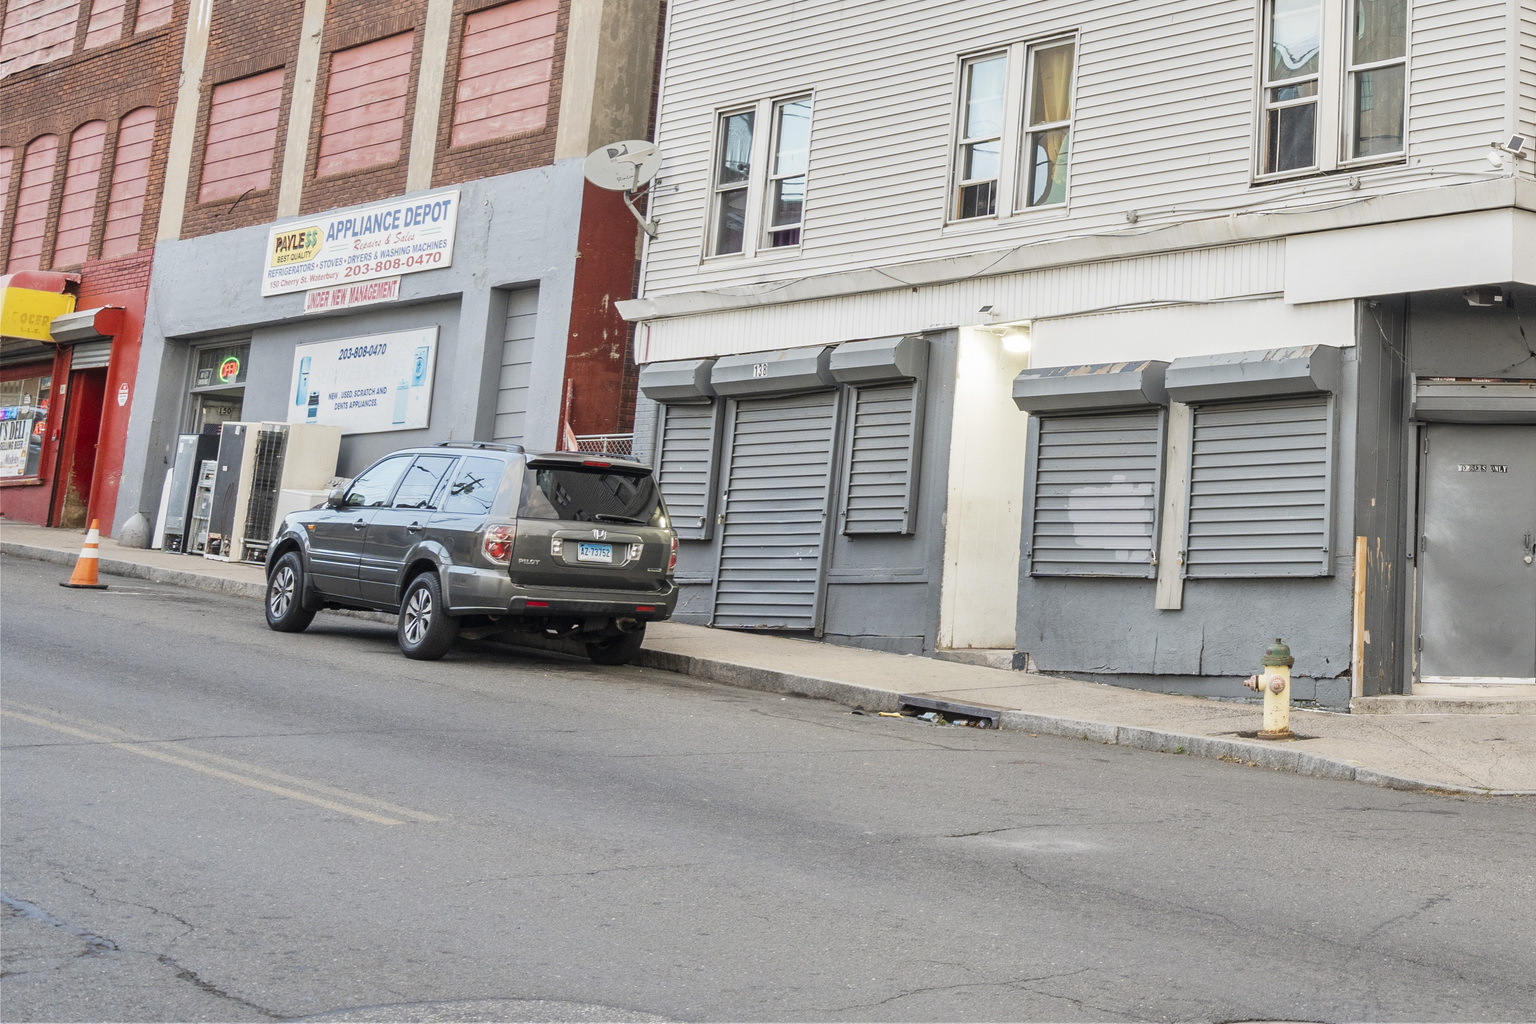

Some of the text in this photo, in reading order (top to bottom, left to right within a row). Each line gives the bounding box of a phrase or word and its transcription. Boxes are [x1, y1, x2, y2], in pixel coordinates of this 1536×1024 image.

[326, 199, 452, 242] APPLIANCE DEPOT
[352, 231, 416, 252] Repairs & Sales
[267, 238, 448, 279] REFRIGERATORS STOVES DRYERS & WASHING MACHINES
[277, 250, 312, 264] BEST QUALITY
[343, 251, 442, 278] 203-808-0470
[269, 280, 280, 289] 150
[280, 277, 299, 289] Cherry
[309, 270, 340, 283] Waterbury
[306, 279, 398, 310] UNDER NEW MANAGEMENT
[338, 343, 388, 361] 203-808-0470
[221, 361, 239, 378] OPEN
[753, 362, 768, 377] 138
[354, 387, 377, 398] SCRATCH
[376, 386, 388, 395] AND
[334, 401, 349, 411] DENTS
[9, 420, 27, 440] DELI
[1490, 464, 1508, 474] ONLY
[517, 557, 541, 566] PILOT
